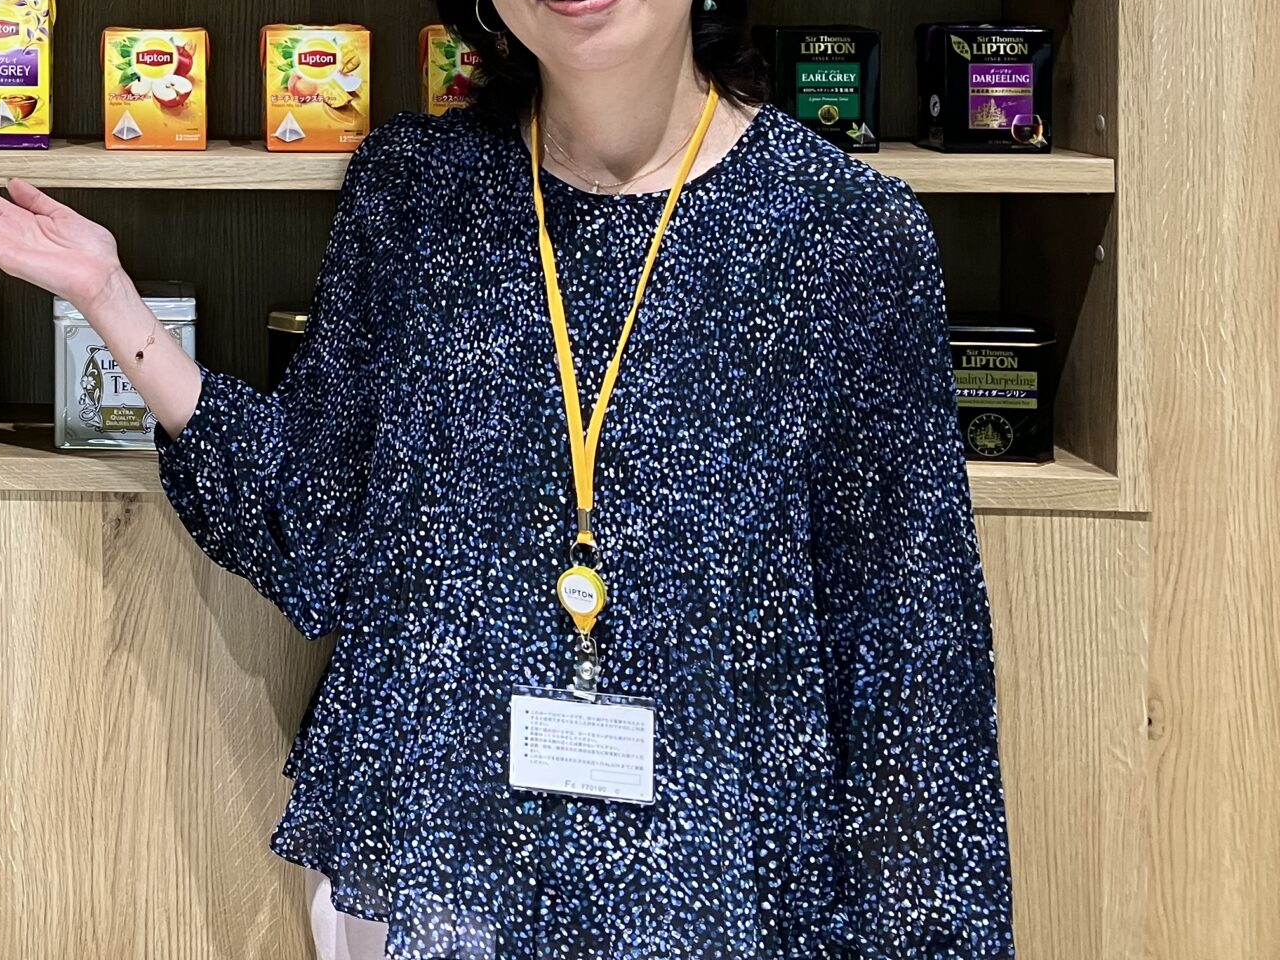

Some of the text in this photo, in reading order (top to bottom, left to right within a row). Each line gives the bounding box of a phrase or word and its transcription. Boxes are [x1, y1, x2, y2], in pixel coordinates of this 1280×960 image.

[800, 42, 855, 54] LIPTON
[972, 43, 1028, 55] LIPTON
[139, 53, 170, 63] Lipton
[301, 54, 333, 64] Lipton
[464, 54, 480, 64] Lip
[0, 65, 31, 76] GREY
[802, 73, 856, 81] EARL GREY
[972, 74, 1030, 84] DARJEELING
[962, 356, 1018, 369] LIPTON
[956, 373, 983, 389] uality
[955, 389, 1027, 397] クオリティダージリン
[564, 586, 593, 599] LIPTON
